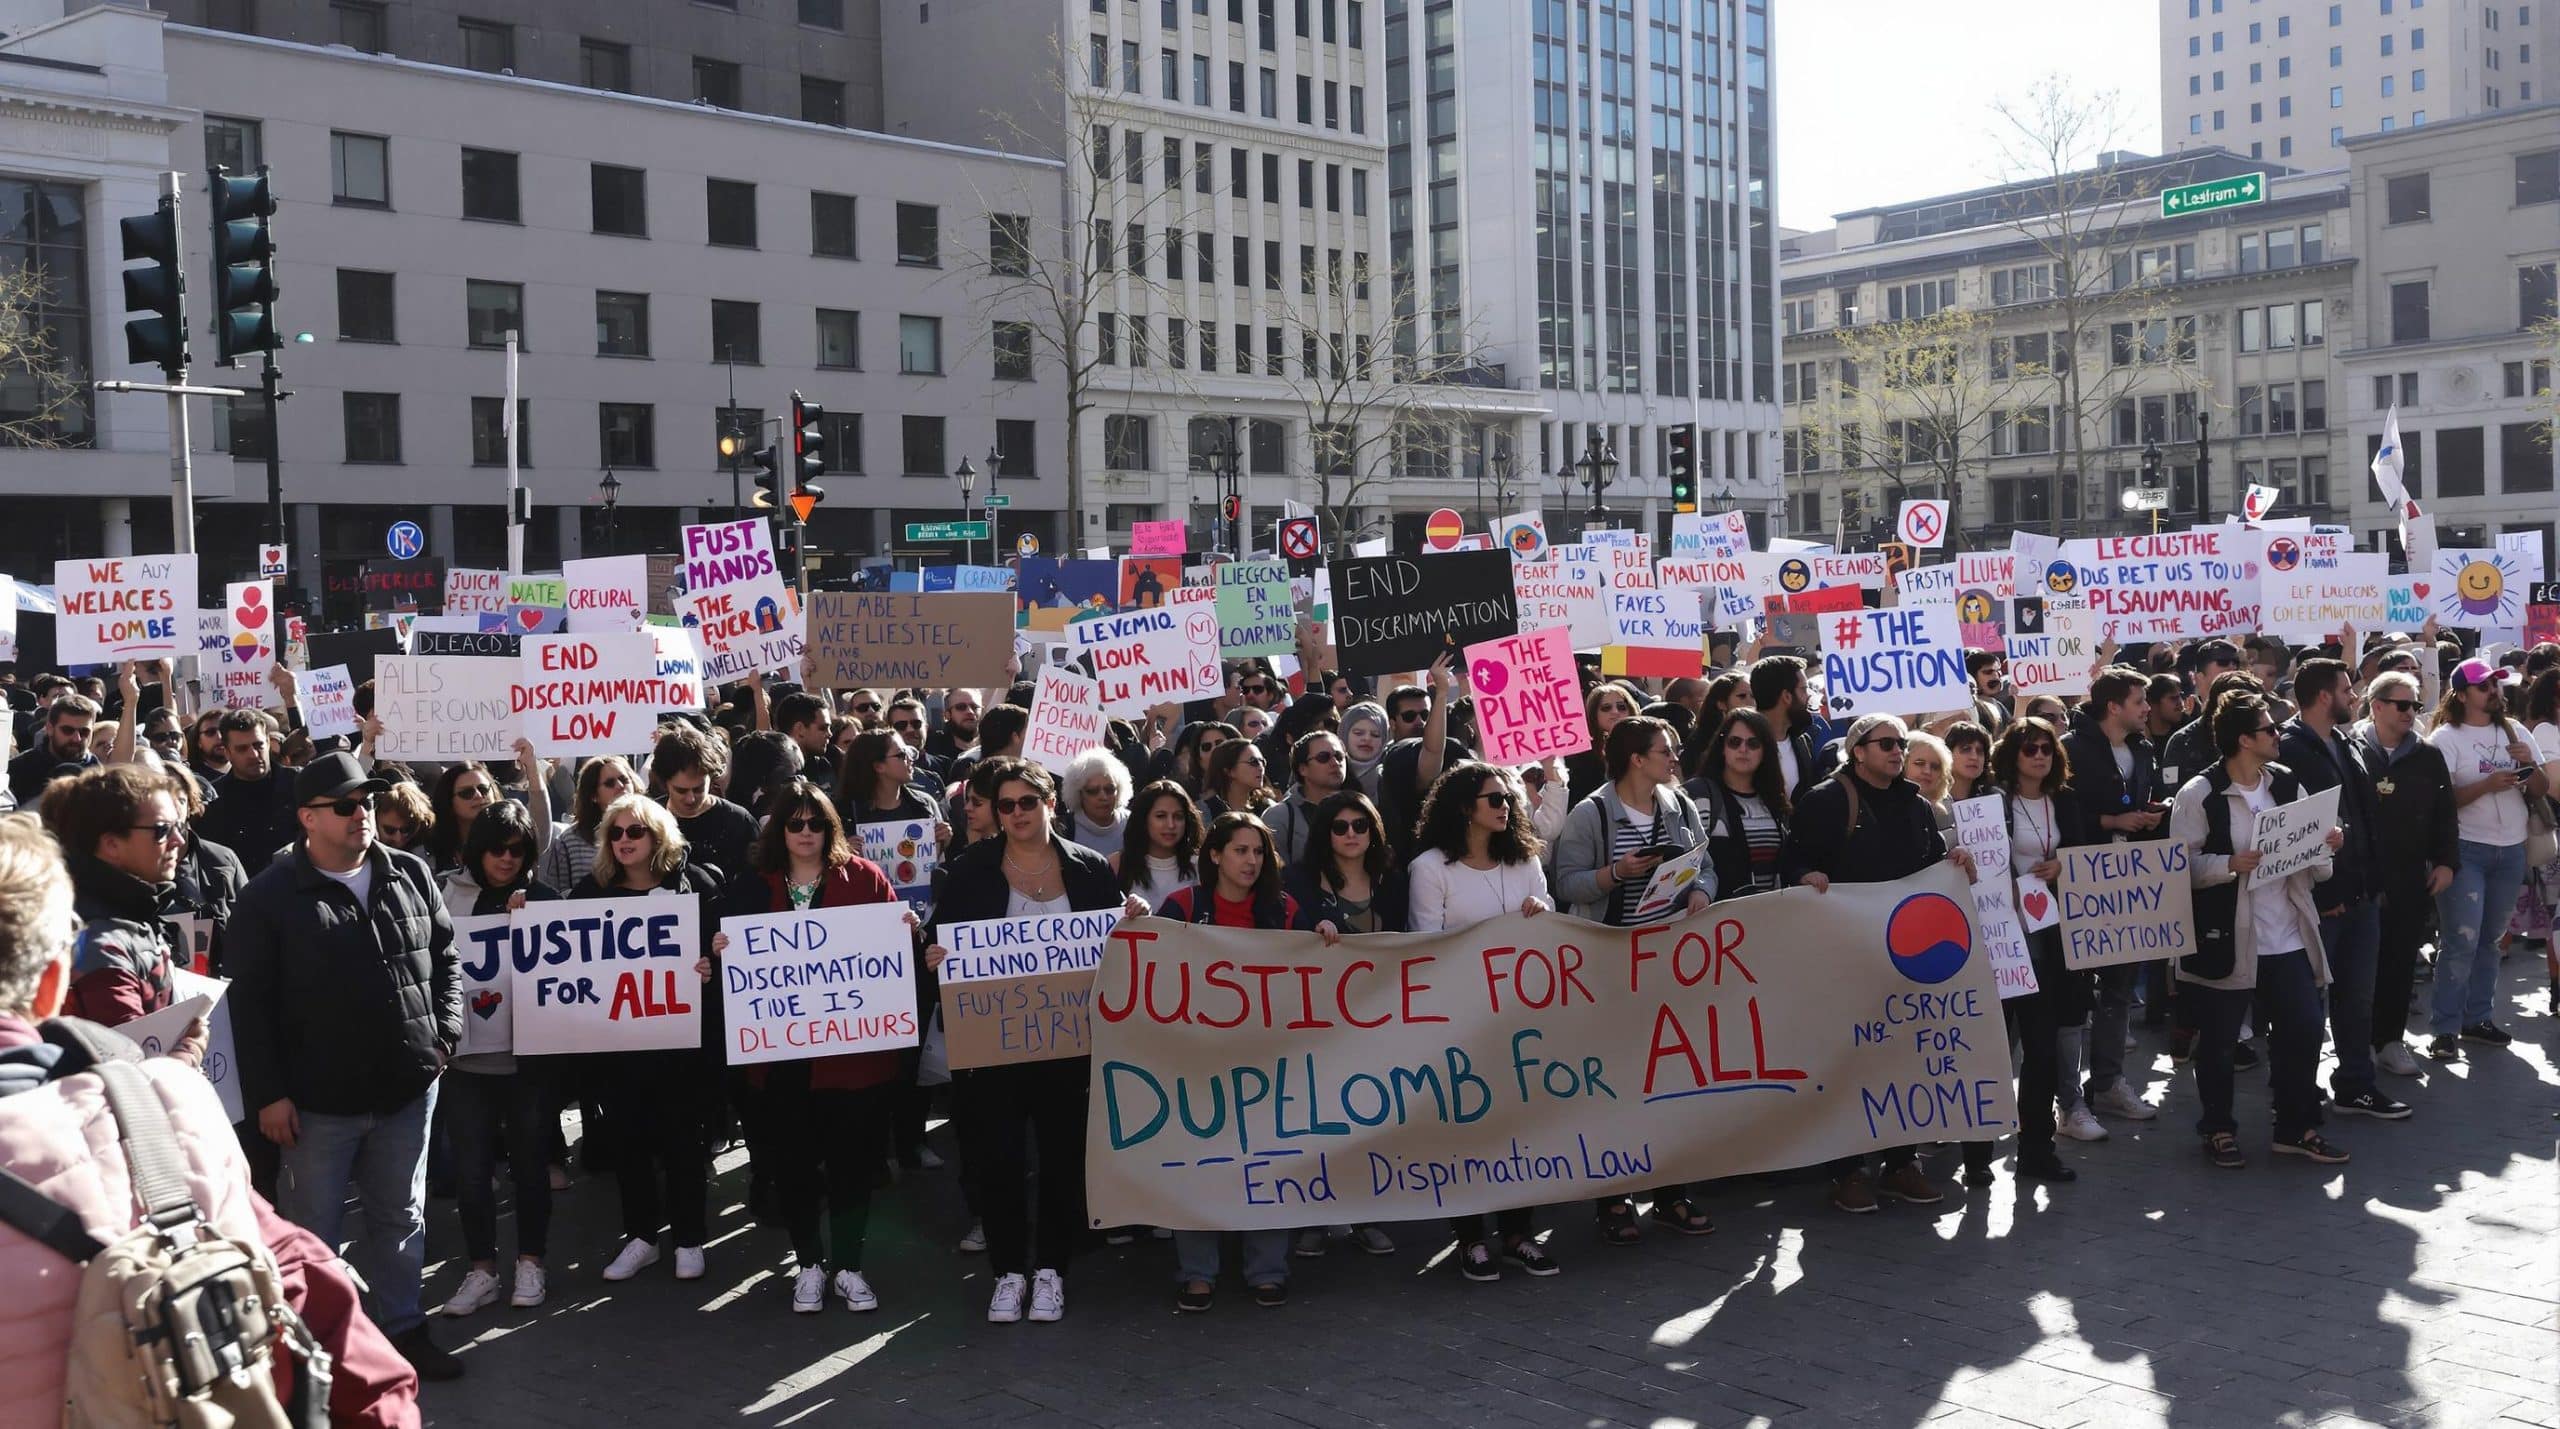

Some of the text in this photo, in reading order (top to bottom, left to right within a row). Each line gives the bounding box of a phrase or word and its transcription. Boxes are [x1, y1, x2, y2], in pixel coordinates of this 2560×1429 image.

[687, 522, 756, 558] FUST
[88, 562, 124, 584] WE
[688, 550, 774, 590] MANDS
[1346, 559, 1421, 601] END
[62, 588, 174, 616] WELACES
[694, 594, 733, 621] THE
[98, 617, 176, 643] LOMBE
[1664, 619, 1700, 637] YOUR
[542, 643, 598, 671] END
[1095, 643, 1150, 671] LOUR
[1499, 638, 1551, 668] THE
[2008, 637, 2050, 659] LUNT
[1141, 667, 1189, 696] MIN
[1519, 664, 1556, 686] THE
[1479, 679, 1583, 735] PLAME
[552, 711, 616, 741] LOW
[2163, 842, 2188, 872] VS
[745, 919, 828, 955] END
[1099, 918, 1758, 1030] JUSTICE FOR FOR
[537, 969, 691, 1021] FOR ALL
[825, 989, 865, 1012] IS
[1916, 1027, 1971, 1053] FOR
[1243, 1152, 1336, 1206] End
[1578, 1134, 1653, 1180] Law
